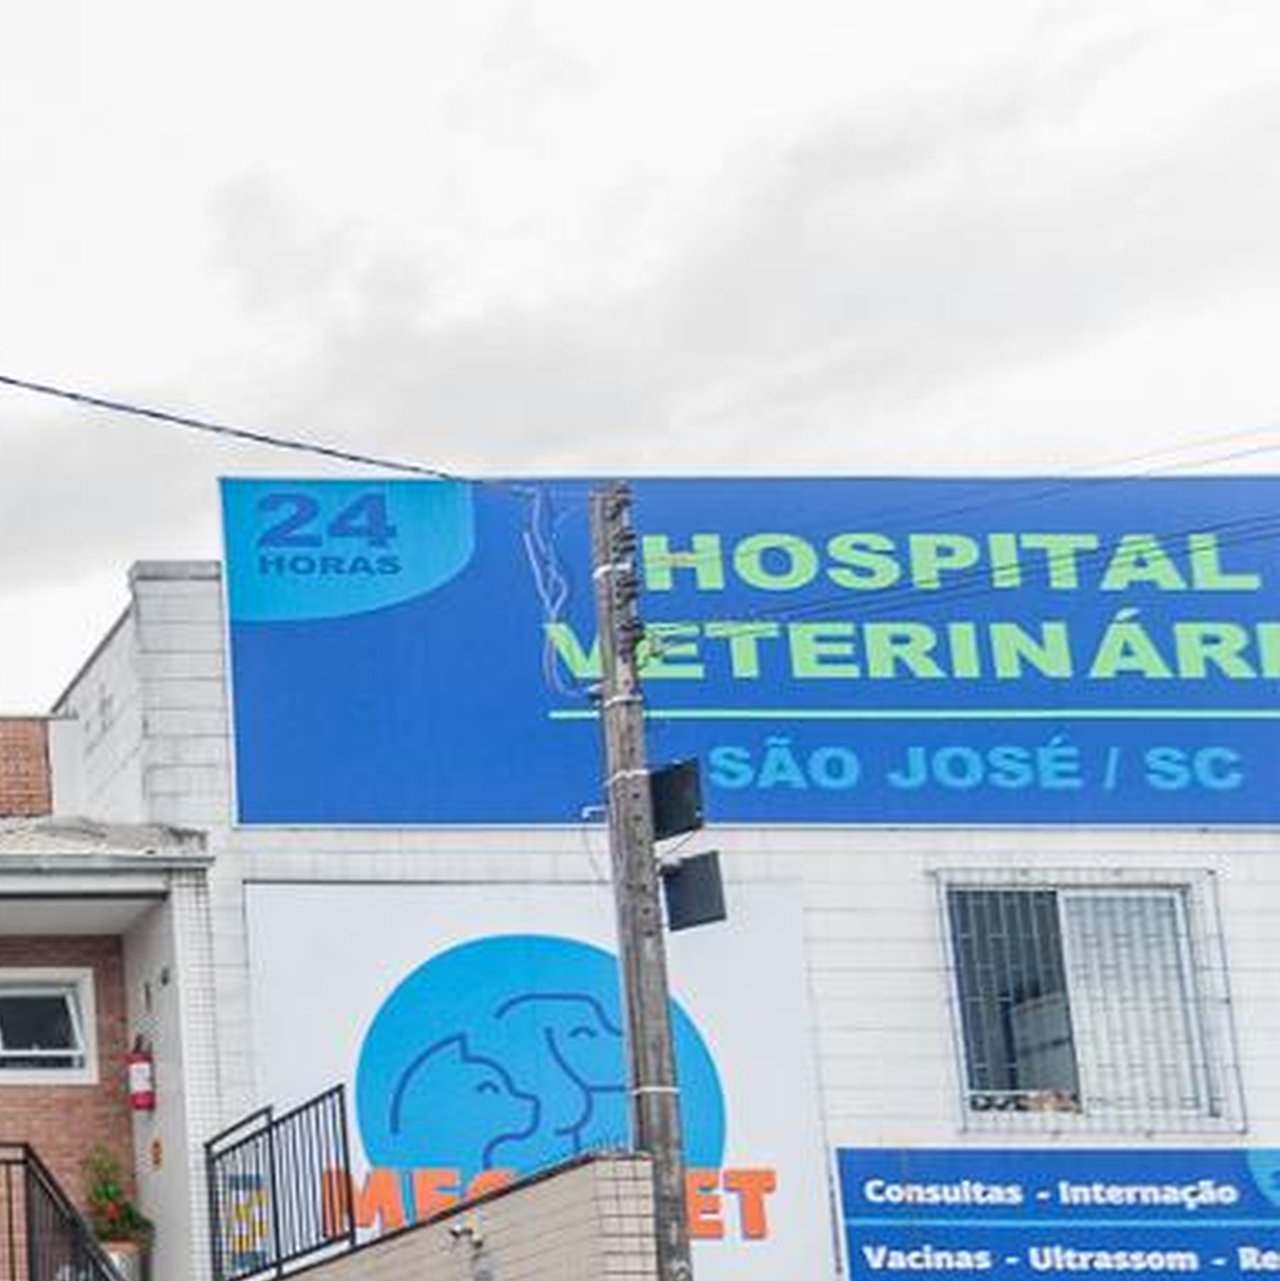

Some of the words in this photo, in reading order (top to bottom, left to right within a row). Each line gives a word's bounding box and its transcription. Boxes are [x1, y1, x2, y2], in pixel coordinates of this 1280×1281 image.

[257, 492, 397, 549] 24
[258, 554, 402, 577] HORAS
[641, 532, 1262, 592] HOSPITAL
[707, 737, 862, 791] SÃO
[887, 736, 1083, 791] JOSÉ
[1103, 746, 1120, 791] /
[1145, 746, 1244, 791] SC
[863, 1178, 1024, 1206] Consultas
[1058, 1180, 1239, 1210] Internação
[862, 1245, 992, 1271] Vacinas
[1029, 1246, 1201, 1271] Ultrassom
